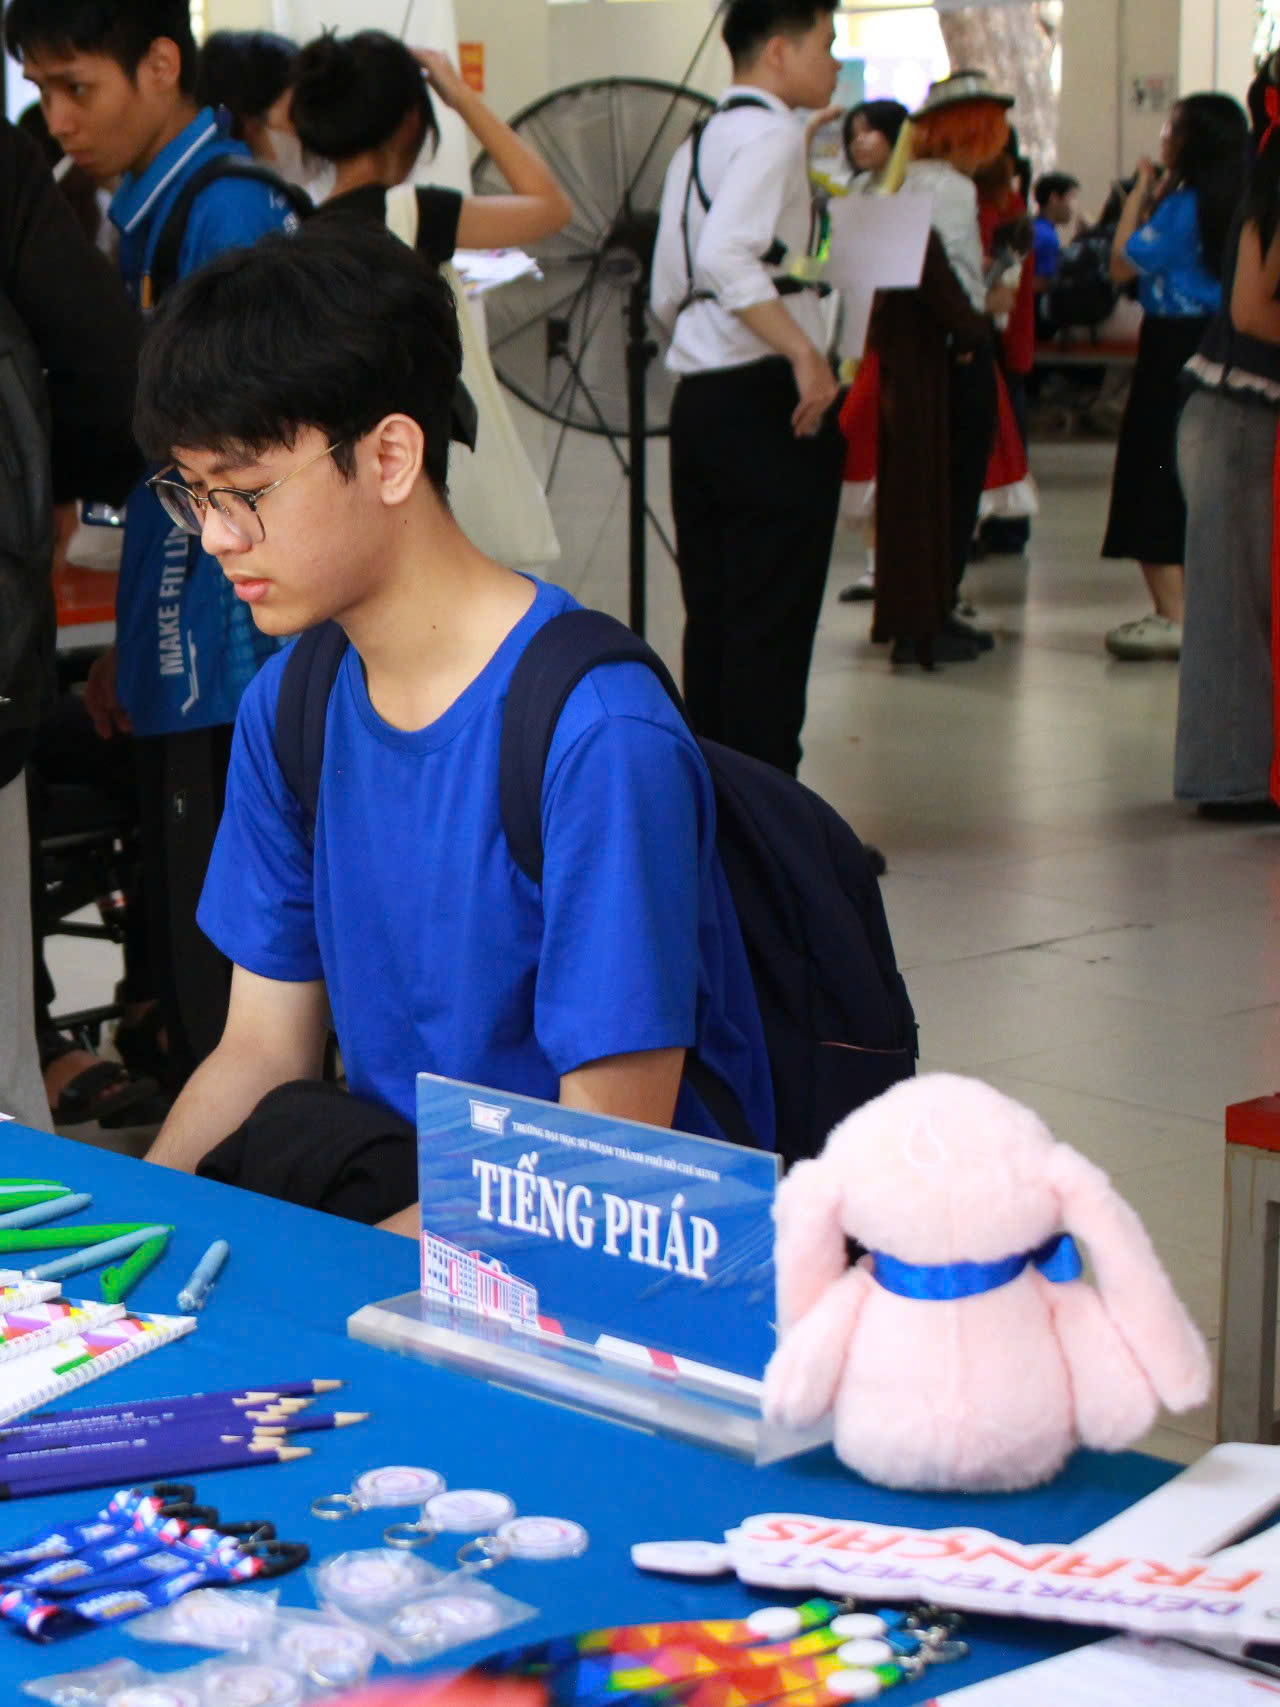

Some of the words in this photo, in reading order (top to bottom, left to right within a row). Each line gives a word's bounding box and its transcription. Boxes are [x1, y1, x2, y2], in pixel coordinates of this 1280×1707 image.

[160, 565, 187, 597] FIT
[159, 603, 186, 675] MAKE
[472, 1150, 595, 1249] TIẾNG
[601, 1192, 718, 1280] PHÁP
[750, 1519, 1265, 1594] FRANÇAIS
